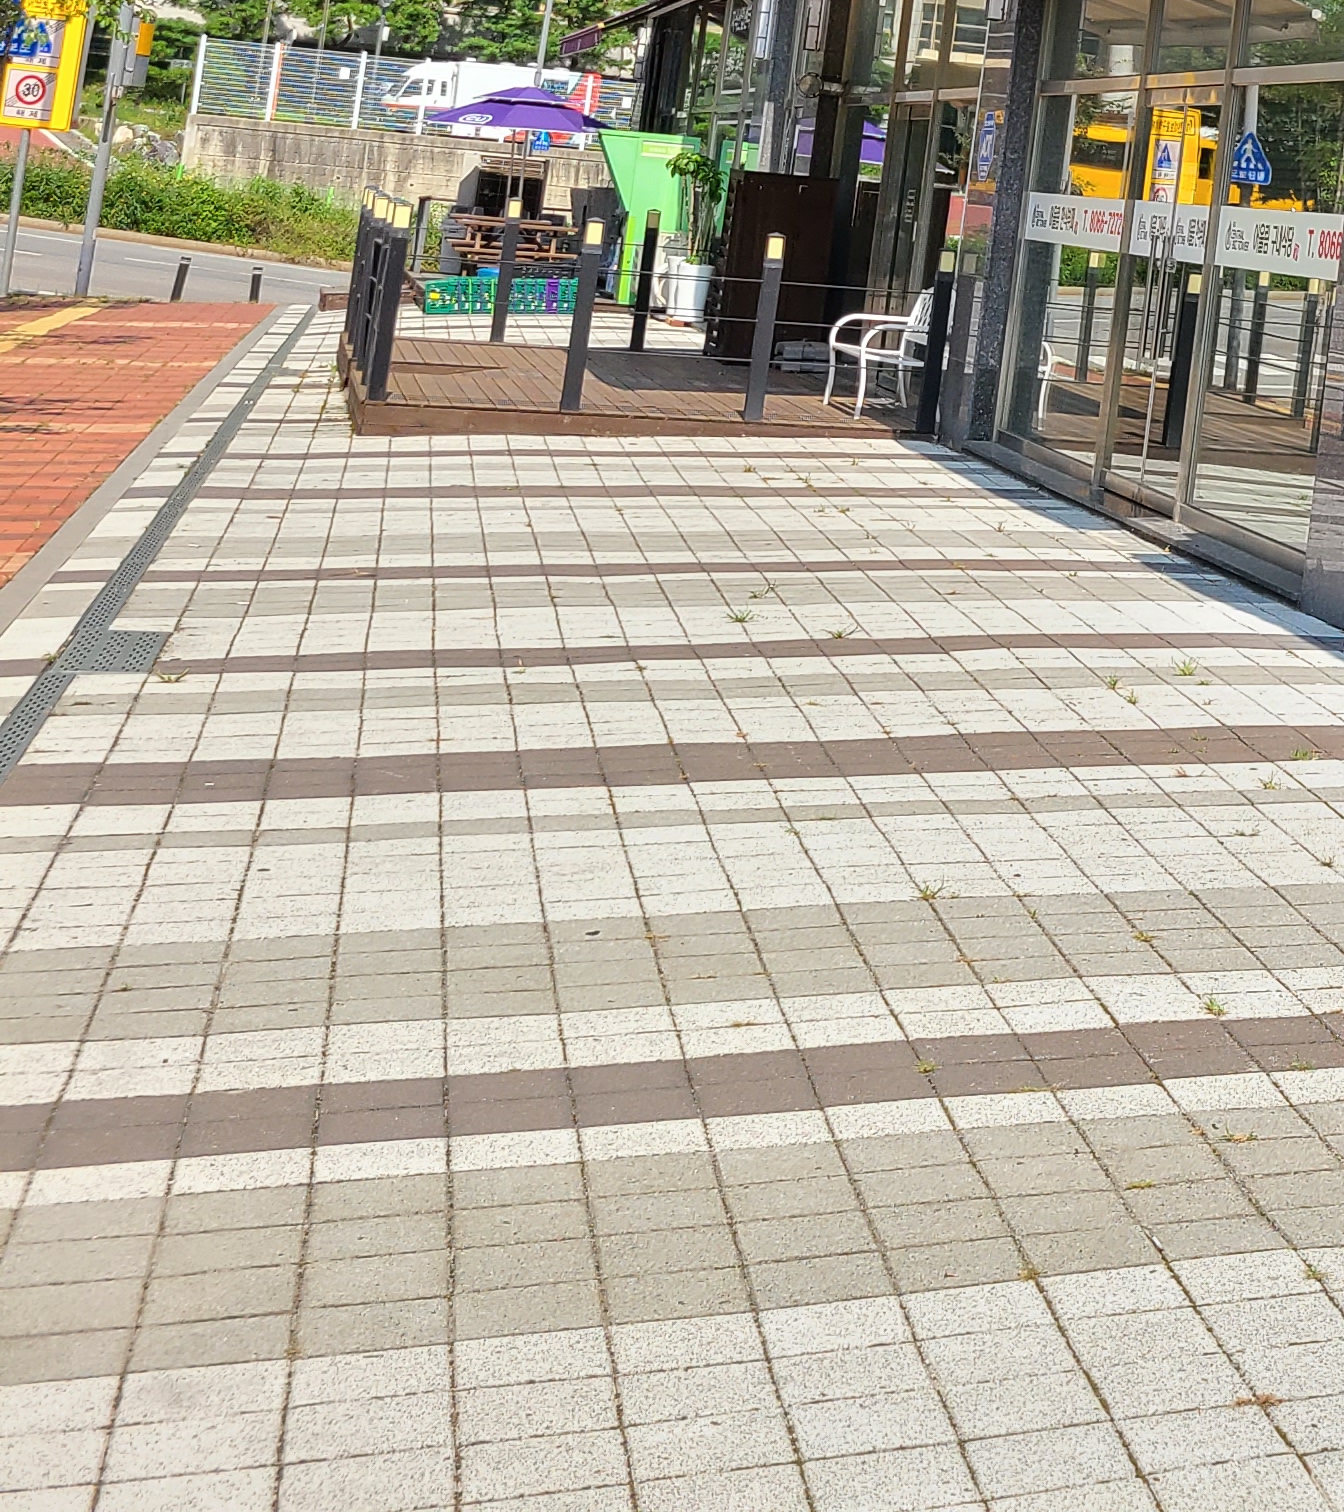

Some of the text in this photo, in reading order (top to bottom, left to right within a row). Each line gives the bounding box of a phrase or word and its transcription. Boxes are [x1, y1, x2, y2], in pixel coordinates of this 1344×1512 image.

[22, 82, 40, 98] 30
[1089, 210, 1123, 236] 8066-7272
[1308, 229, 1314, 259] T.
